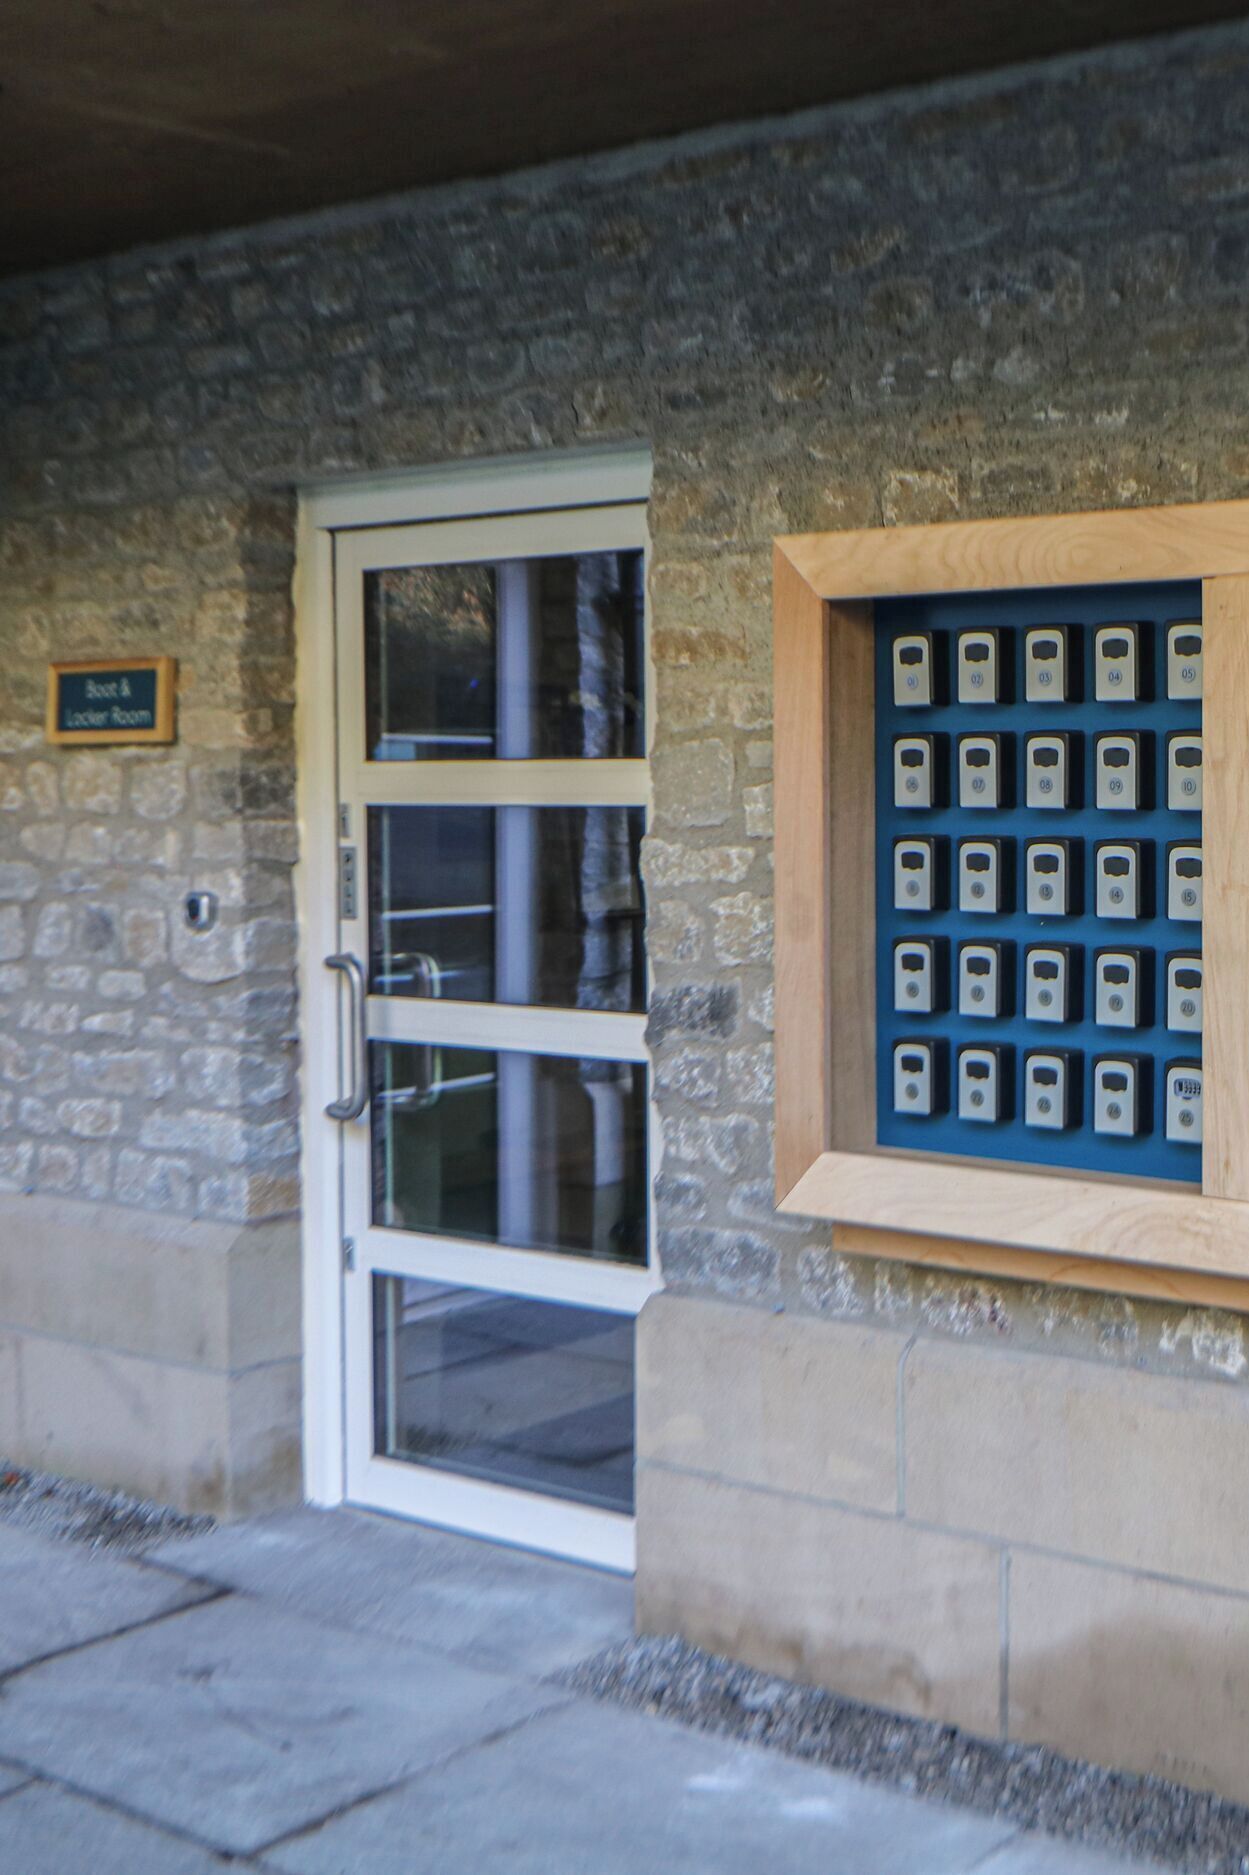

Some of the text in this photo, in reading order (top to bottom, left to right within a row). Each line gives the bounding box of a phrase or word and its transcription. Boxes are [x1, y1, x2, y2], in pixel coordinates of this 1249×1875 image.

[970, 673, 981, 684] 02
[1039, 672, 1050, 682] 03
[1108, 671, 1120, 682] 04
[1182, 668, 1193, 679] 05
[907, 676, 915, 687] 01
[85, 677, 132, 699] Boot &
[65, 705, 153, 728] Locker Room
[972, 779, 984, 790] 07
[1039, 779, 1050, 790] 08
[1109, 781, 1121, 791] 09
[1184, 781, 1193, 792] 10
[1042, 886, 1050, 897] 13
[1111, 889, 1120, 899] 14
[1184, 891, 1192, 902] 15
[1182, 1002, 1193, 1012] 20
